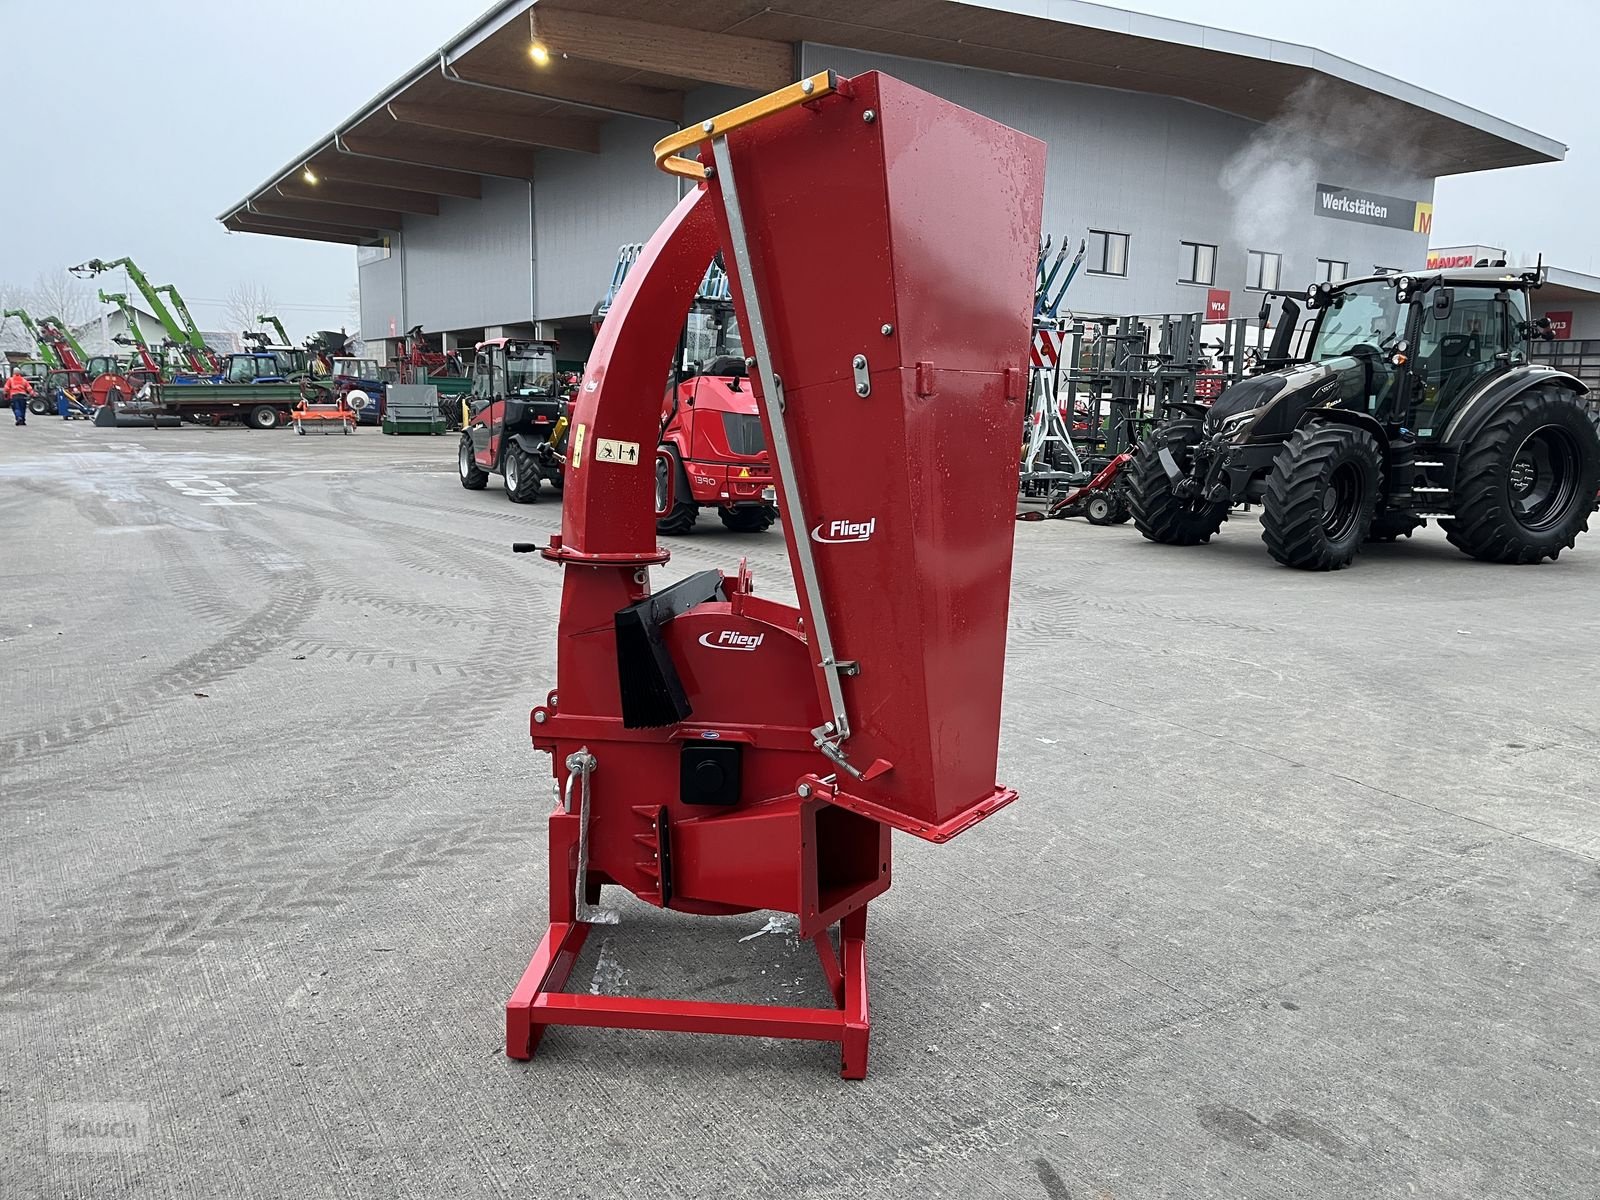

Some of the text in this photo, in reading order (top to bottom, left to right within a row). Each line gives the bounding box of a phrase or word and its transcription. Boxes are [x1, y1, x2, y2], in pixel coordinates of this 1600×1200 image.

[1322, 192, 1387, 218] Werkstätten
[1426, 256, 1473, 270] MAUCH
[1211, 301, 1226, 312] W14
[1550, 321, 1567, 329] W13
[694, 476, 716, 486] 1390
[830, 517, 876, 539] Fliegl
[718, 630, 765, 649] Fliegl
